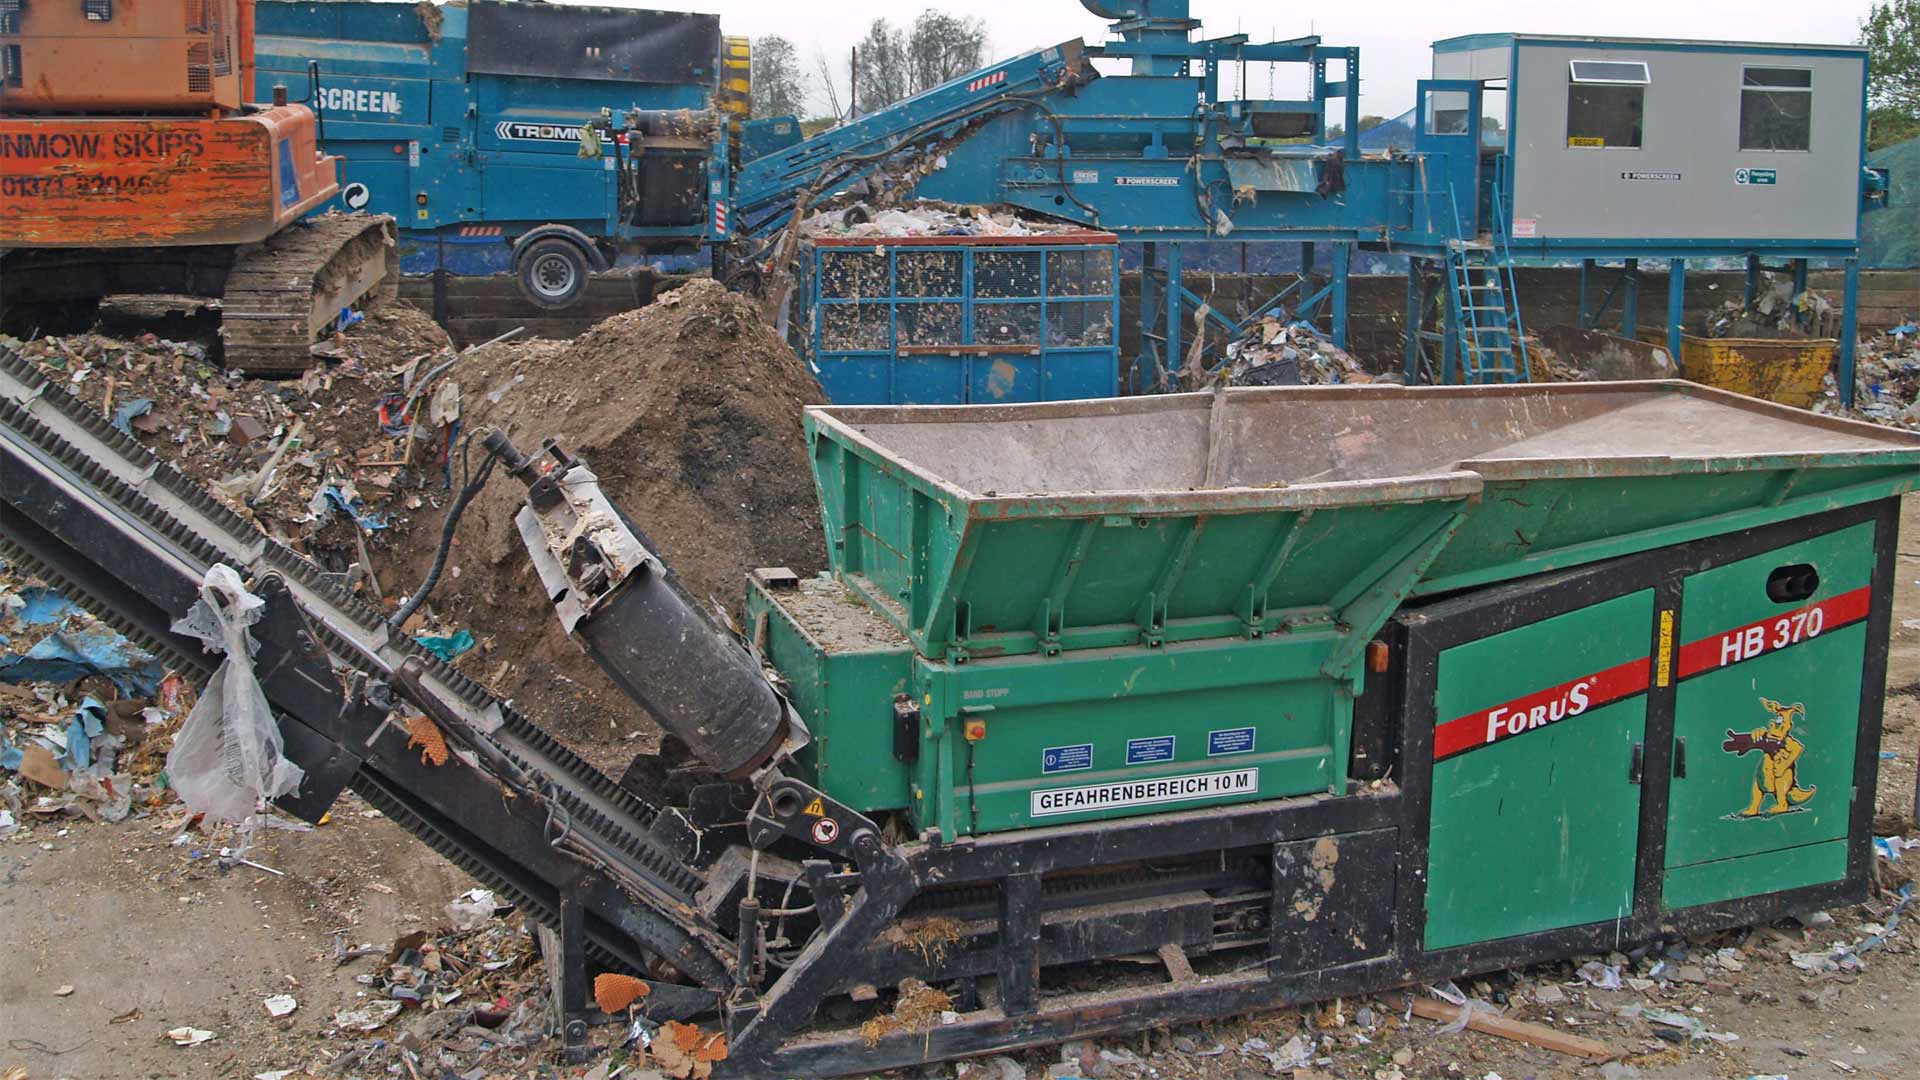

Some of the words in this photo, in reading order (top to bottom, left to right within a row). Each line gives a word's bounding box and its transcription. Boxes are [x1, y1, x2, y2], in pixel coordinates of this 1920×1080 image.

[314, 87, 397, 113] SCREEN
[0, 133, 100, 158] NMOW
[113, 132, 205, 158] SKIPS
[1720, 625, 1765, 666] HB
[1773, 607, 1824, 649] 370
[1040, 777, 1208, 809] GEFAHRENBEREICH
[1213, 775, 1231, 790] 10
[1235, 773, 1249, 788] M
